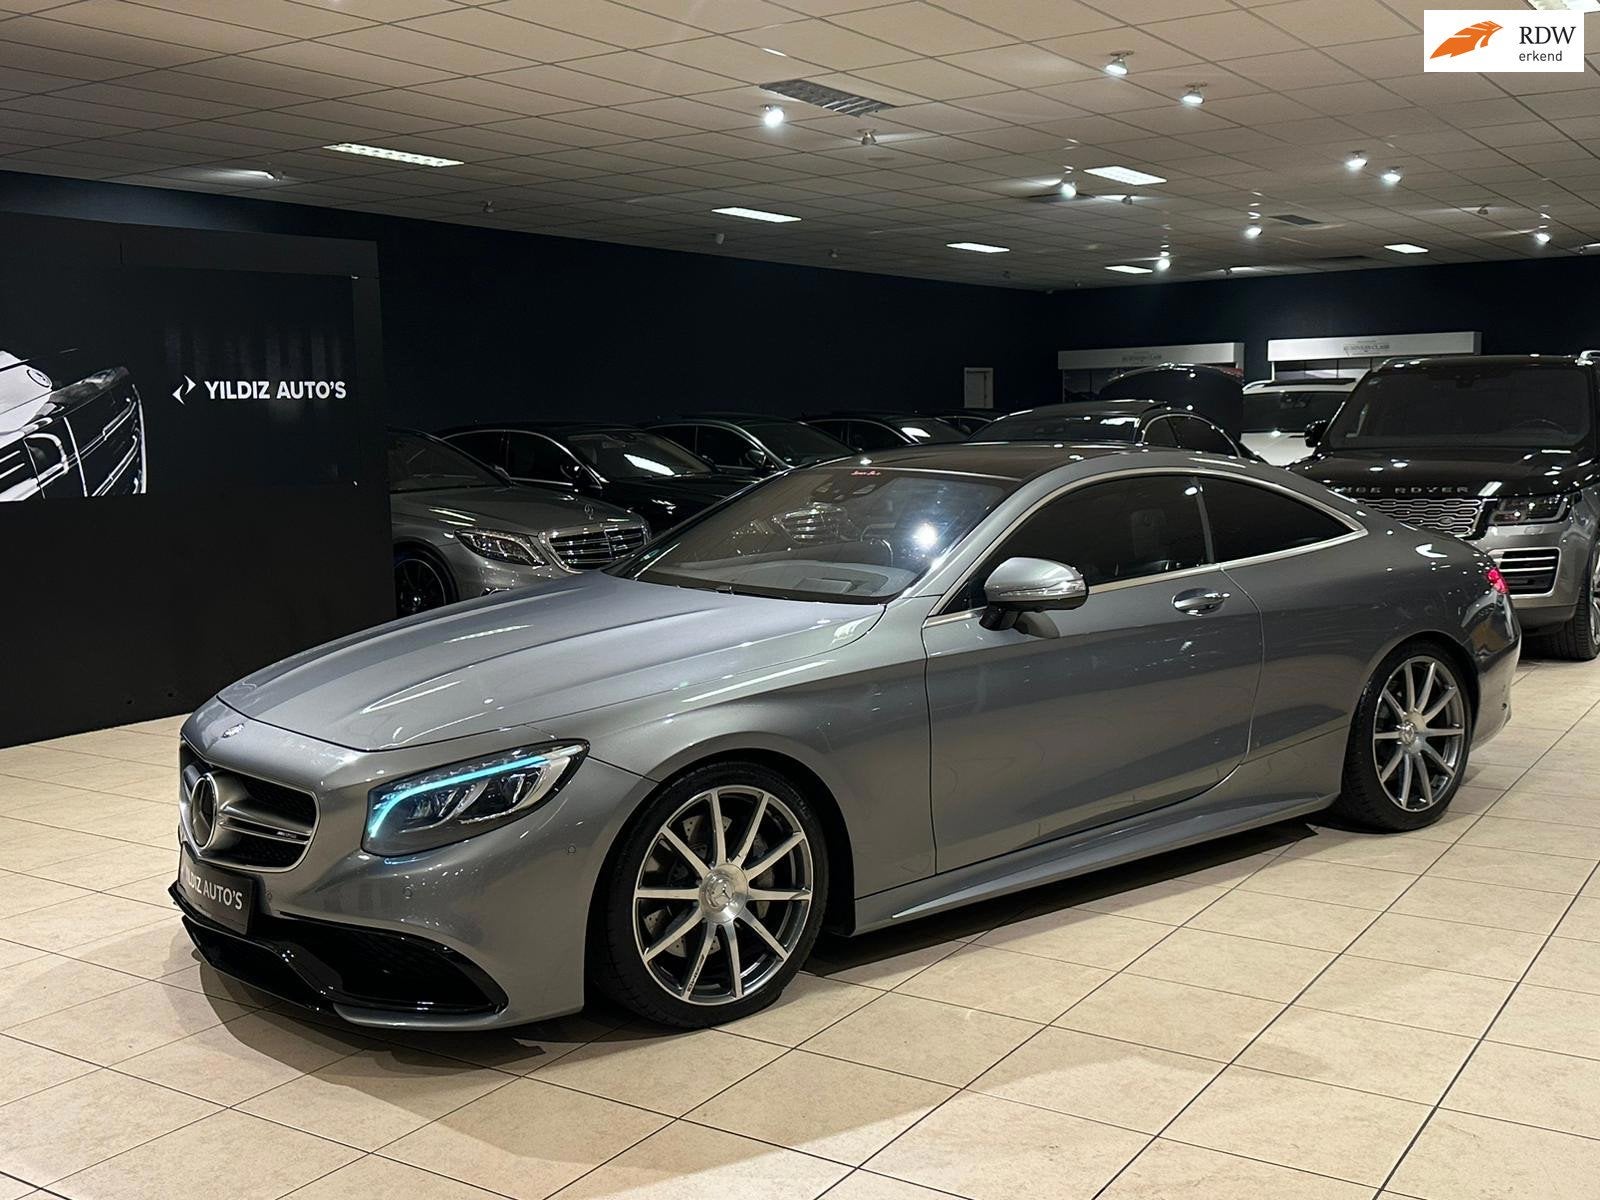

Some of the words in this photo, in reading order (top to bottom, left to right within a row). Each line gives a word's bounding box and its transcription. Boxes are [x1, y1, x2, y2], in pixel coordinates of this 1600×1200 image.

[204, 380, 270, 400] YILDIZ
[276, 380, 347, 400] AUTO'S
[1394, 486, 1469, 494] ROVER
[202, 879, 243, 911] AUTO'S
